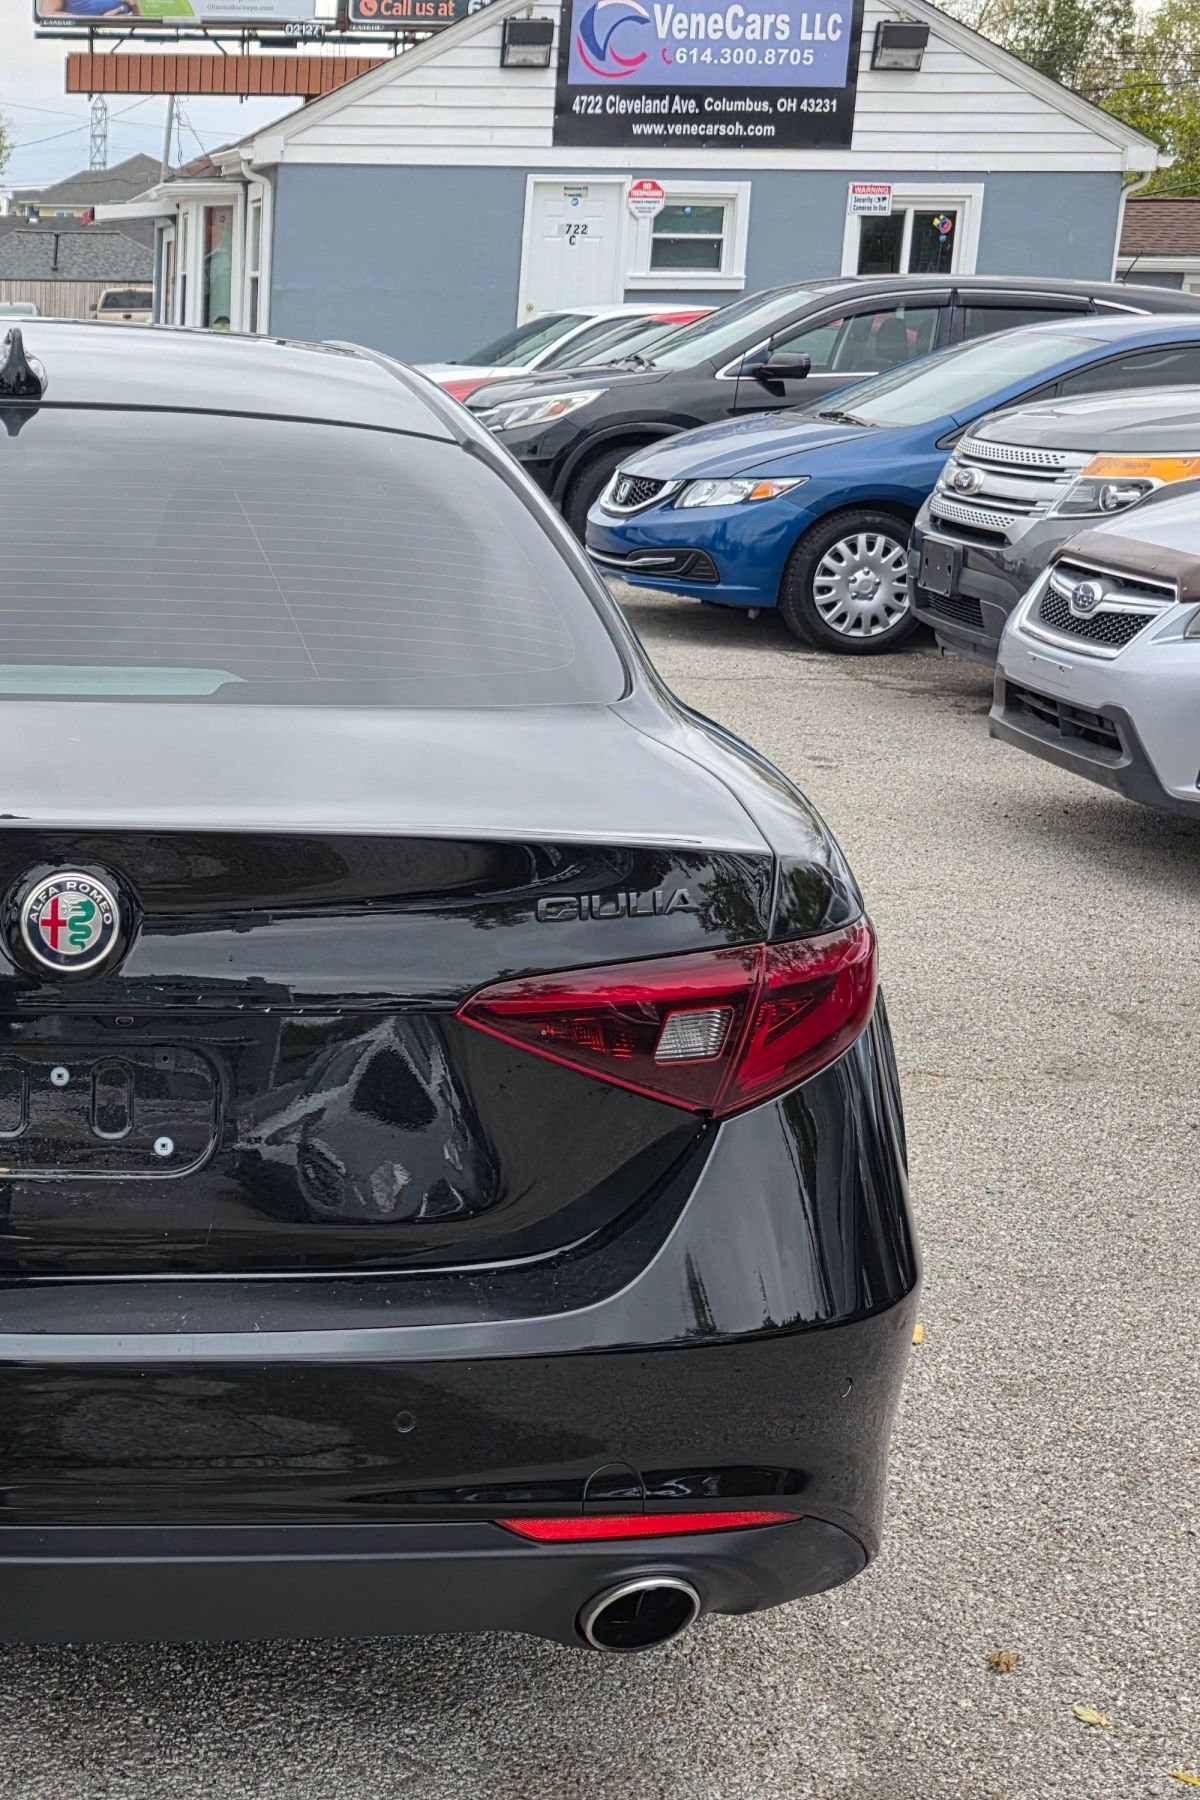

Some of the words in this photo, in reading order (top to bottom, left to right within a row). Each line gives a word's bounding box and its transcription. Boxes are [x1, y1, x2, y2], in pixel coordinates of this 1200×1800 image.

[380, 0, 411, 16] Call
[415, 2, 434, 16] us
[437, 0, 455, 16] at
[653, 3, 791, 41] VeneCars
[800, 12, 842, 41] LLC
[675, 48, 814, 65] 614.300.8705
[572, 95, 602, 114] 4722
[606, 95, 669, 114] Cleveland
[671, 95, 699, 114] Ave.
[704, 97, 773, 115] Columbus,
[777, 98, 797, 113] OH
[800, 98, 837, 113] 43231
[632, 121, 775, 137] www.venecarsoh.com
[853, 186, 889, 194] WARNING
[569, 235, 576, 246] C
[29, 886, 59, 924] ALFA
[65, 881, 113, 925] ROMEO
[536, 888, 700, 923] GIULIA
